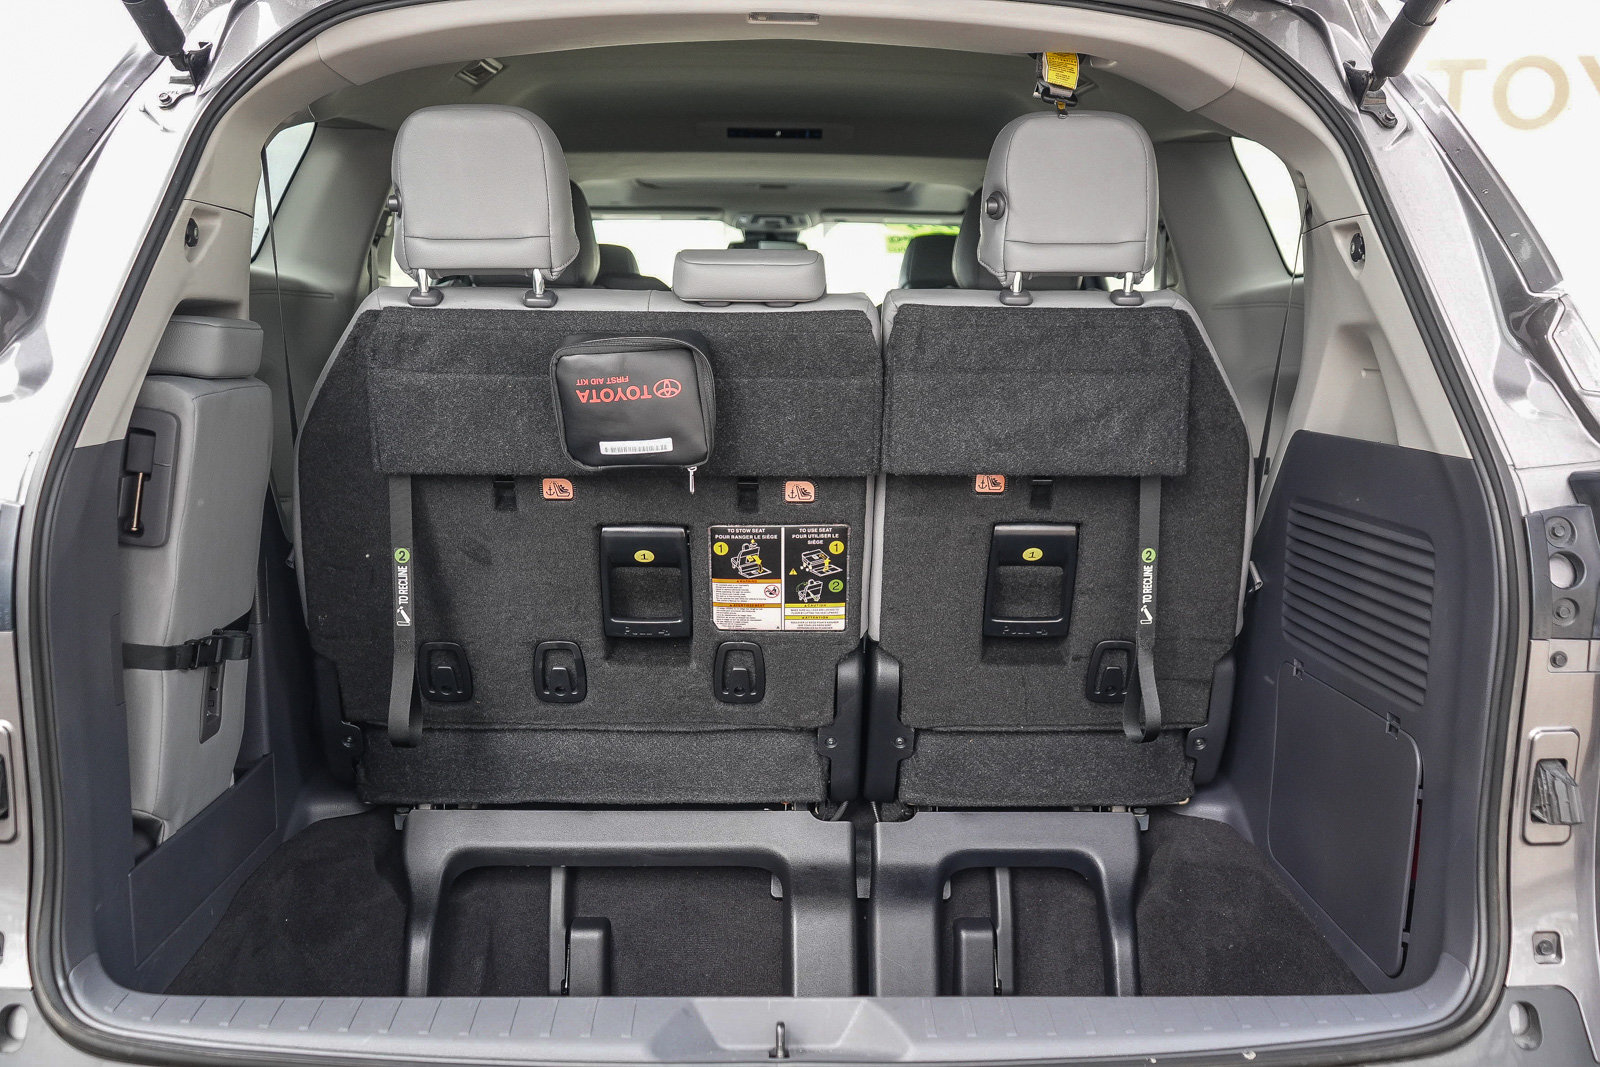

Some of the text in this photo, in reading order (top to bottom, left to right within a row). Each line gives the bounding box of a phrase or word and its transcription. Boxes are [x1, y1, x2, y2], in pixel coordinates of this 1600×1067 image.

[576, 375, 629, 386] FIRST AID KIT
[575, 384, 652, 403] TOYOTA
[398, 550, 406, 561] 2
[1145, 550, 1152, 561] 2
[397, 565, 409, 605] TO RECLINE
[832, 581, 840, 591] 2
[1142, 565, 1153, 604] TO RECLINE
